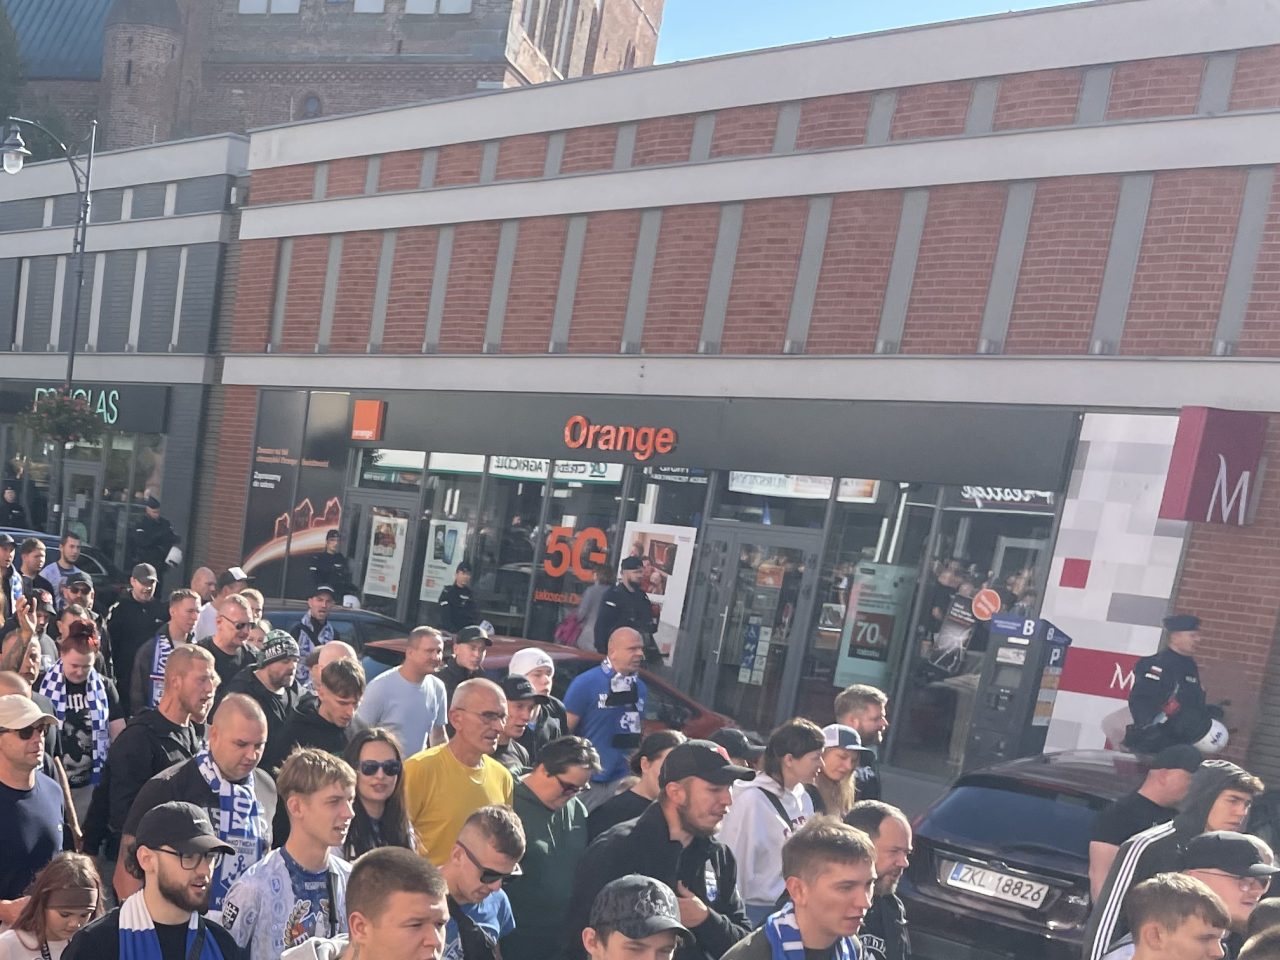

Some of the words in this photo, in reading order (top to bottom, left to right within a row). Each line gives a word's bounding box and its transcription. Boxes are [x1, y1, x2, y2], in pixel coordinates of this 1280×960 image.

[564, 415, 677, 461] Orange
[1206, 454, 1250, 525] M
[544, 526, 608, 582] 5G
[856, 621, 879, 644] 70
[1022, 620, 1035, 635] B
[1050, 649, 1060, 664] P
[959, 866, 987, 888] ZKL
[996, 876, 1044, 902] 18826
